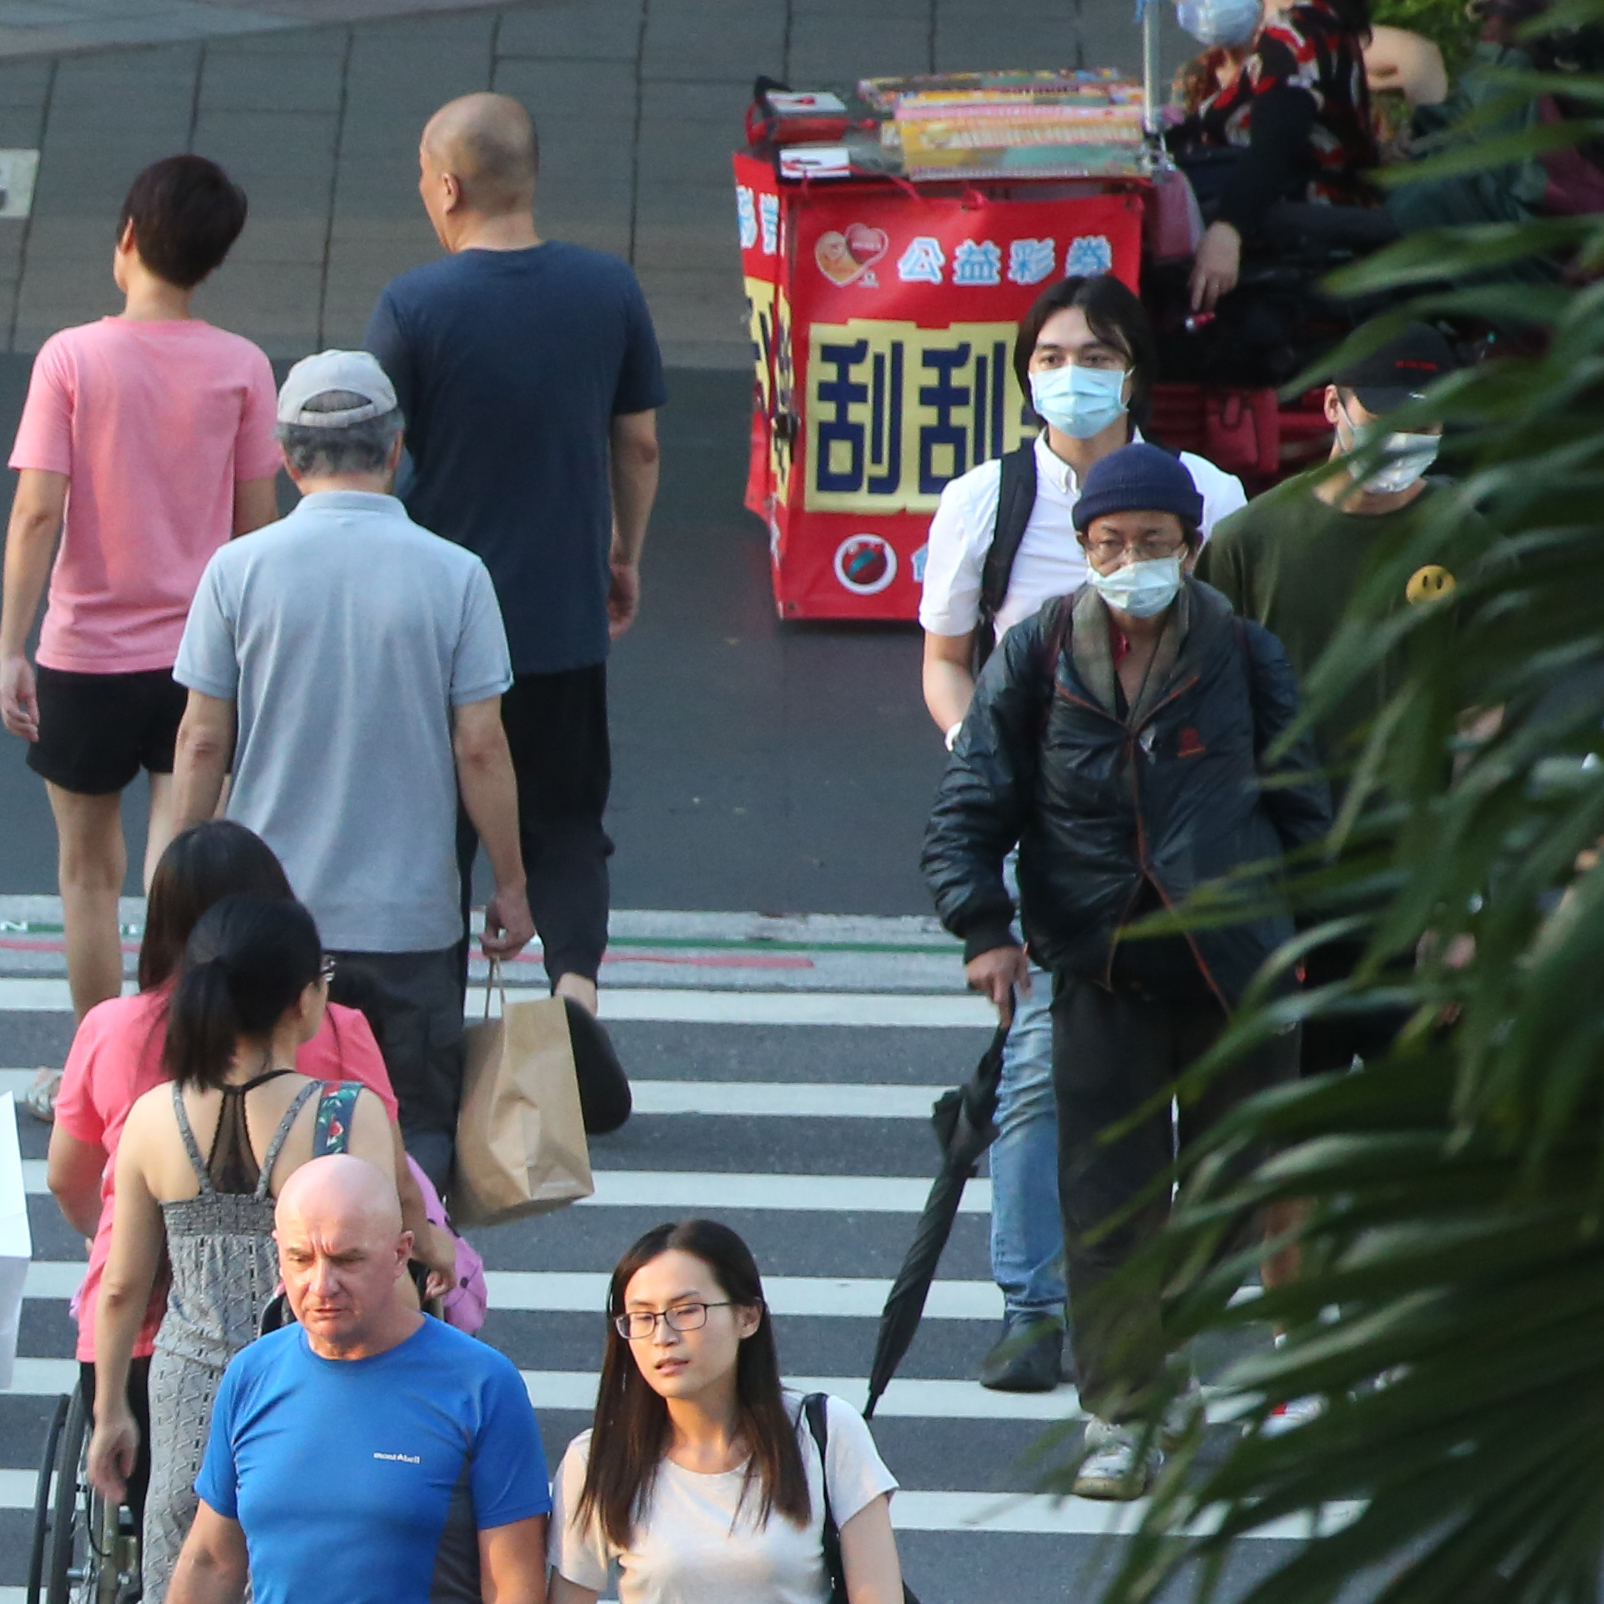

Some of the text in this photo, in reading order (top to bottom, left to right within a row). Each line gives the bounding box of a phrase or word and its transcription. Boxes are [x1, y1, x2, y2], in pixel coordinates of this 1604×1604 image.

[897, 235, 1112, 286] 公益彩券
[816, 339, 1038, 494] 刮刮
